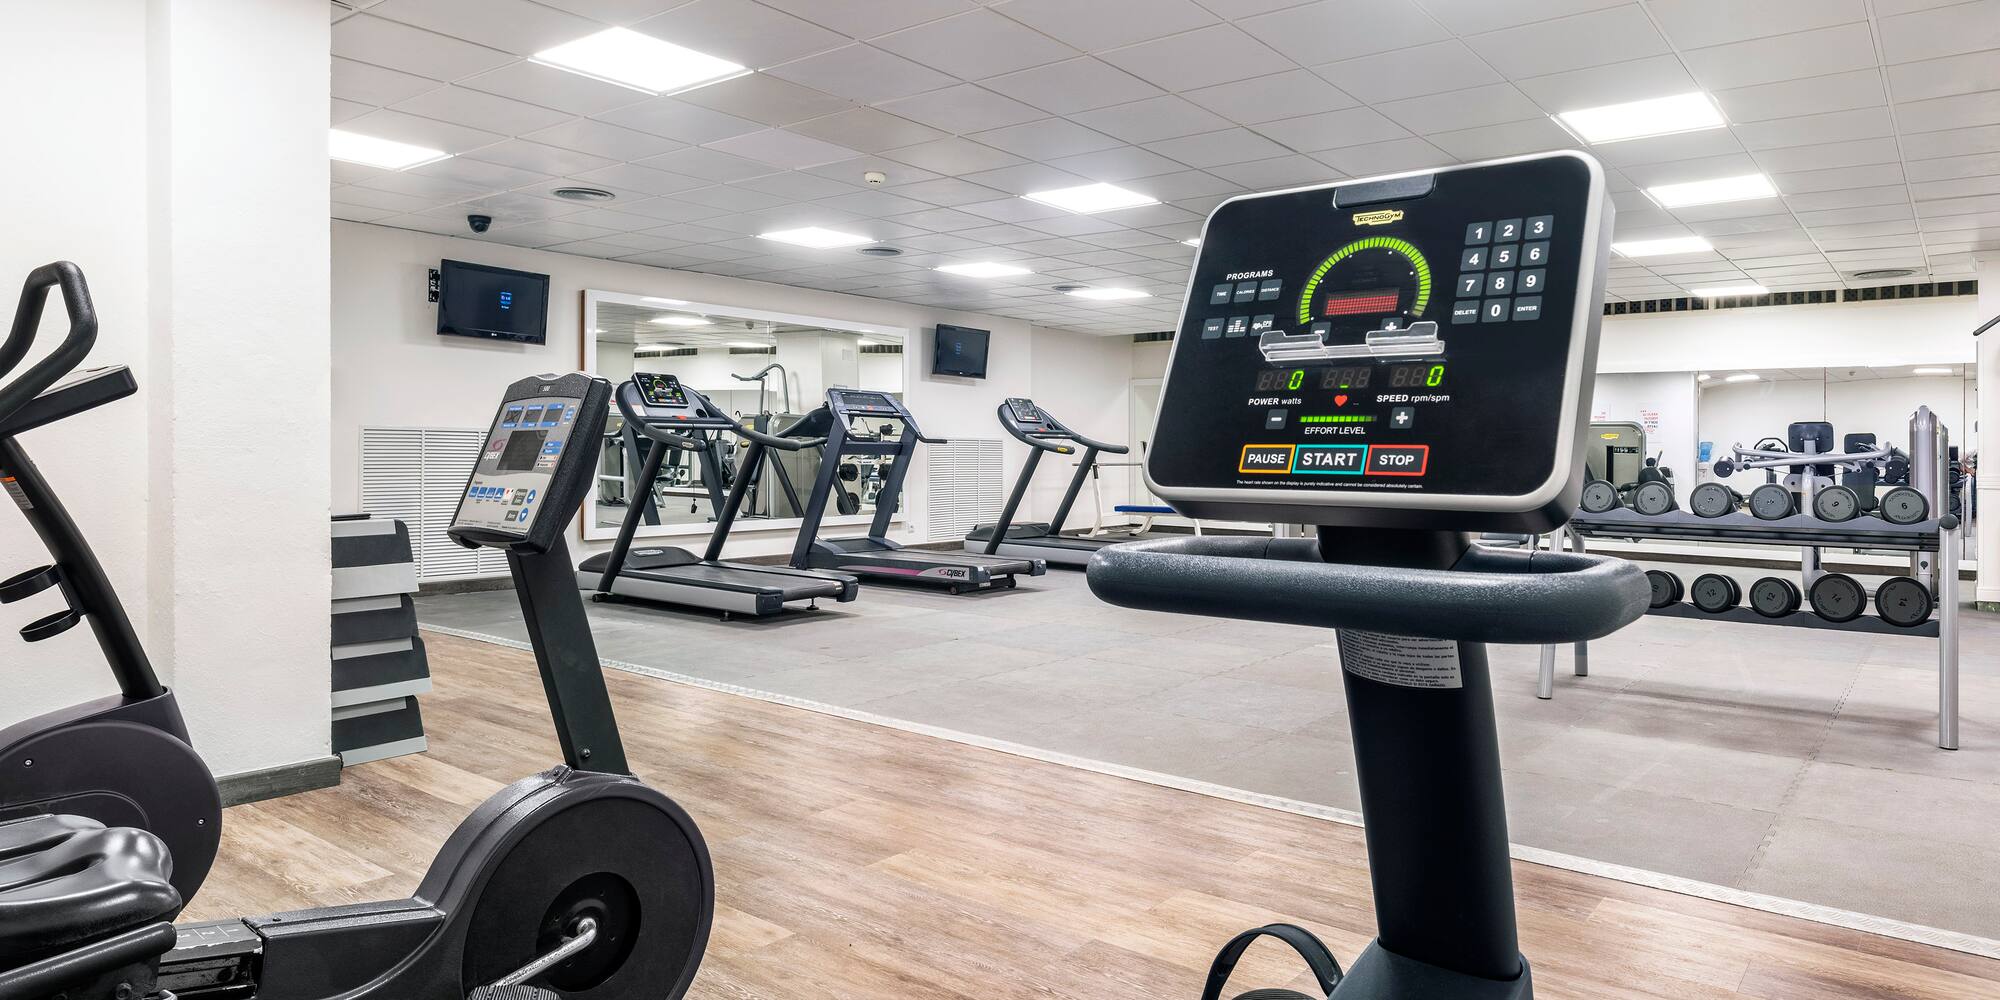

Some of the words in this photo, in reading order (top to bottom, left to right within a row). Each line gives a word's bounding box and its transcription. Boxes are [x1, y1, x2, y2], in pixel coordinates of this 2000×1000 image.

[1354, 212, 1401, 223] TECHNOGYM
[1475, 228, 1483, 240] 1
[1503, 224, 1514, 237] 2
[1534, 221, 1545, 234] 3
[1469, 253, 1480, 265] 4
[1499, 250, 1510, 263] 5
[1530, 247, 1541, 260] 6
[1226, 269, 1274, 281] PROGRAMS
[1465, 279, 1476, 292] 7
[1495, 277, 1505, 290] 8
[1526, 274, 1537, 288] 9
[1491, 304, 1501, 317] 0
[1288, 370, 1305, 390] 0
[1426, 365, 1445, 387] 0
[1248, 397, 1279, 406] POWER
[1281, 397, 1302, 405] watts
[1376, 394, 1409, 403] SPEED
[1410, 394, 1450, 404] rpm/spm
[1304, 426, 1338, 435] EFFORT
[1339, 426, 1366, 435] LEVEL
[1247, 453, 1286, 464] PAUSE
[1302, 453, 1358, 466] START
[1379, 454, 1415, 466] STOP
[1901, 502, 1908, 510] 6
[946, 569, 967, 578] CYBEX
[1706, 588, 1717, 598] 12
[1766, 592, 1776, 602] 12
[1831, 593, 1841, 603] 14
[1898, 597, 1908, 607] 14
